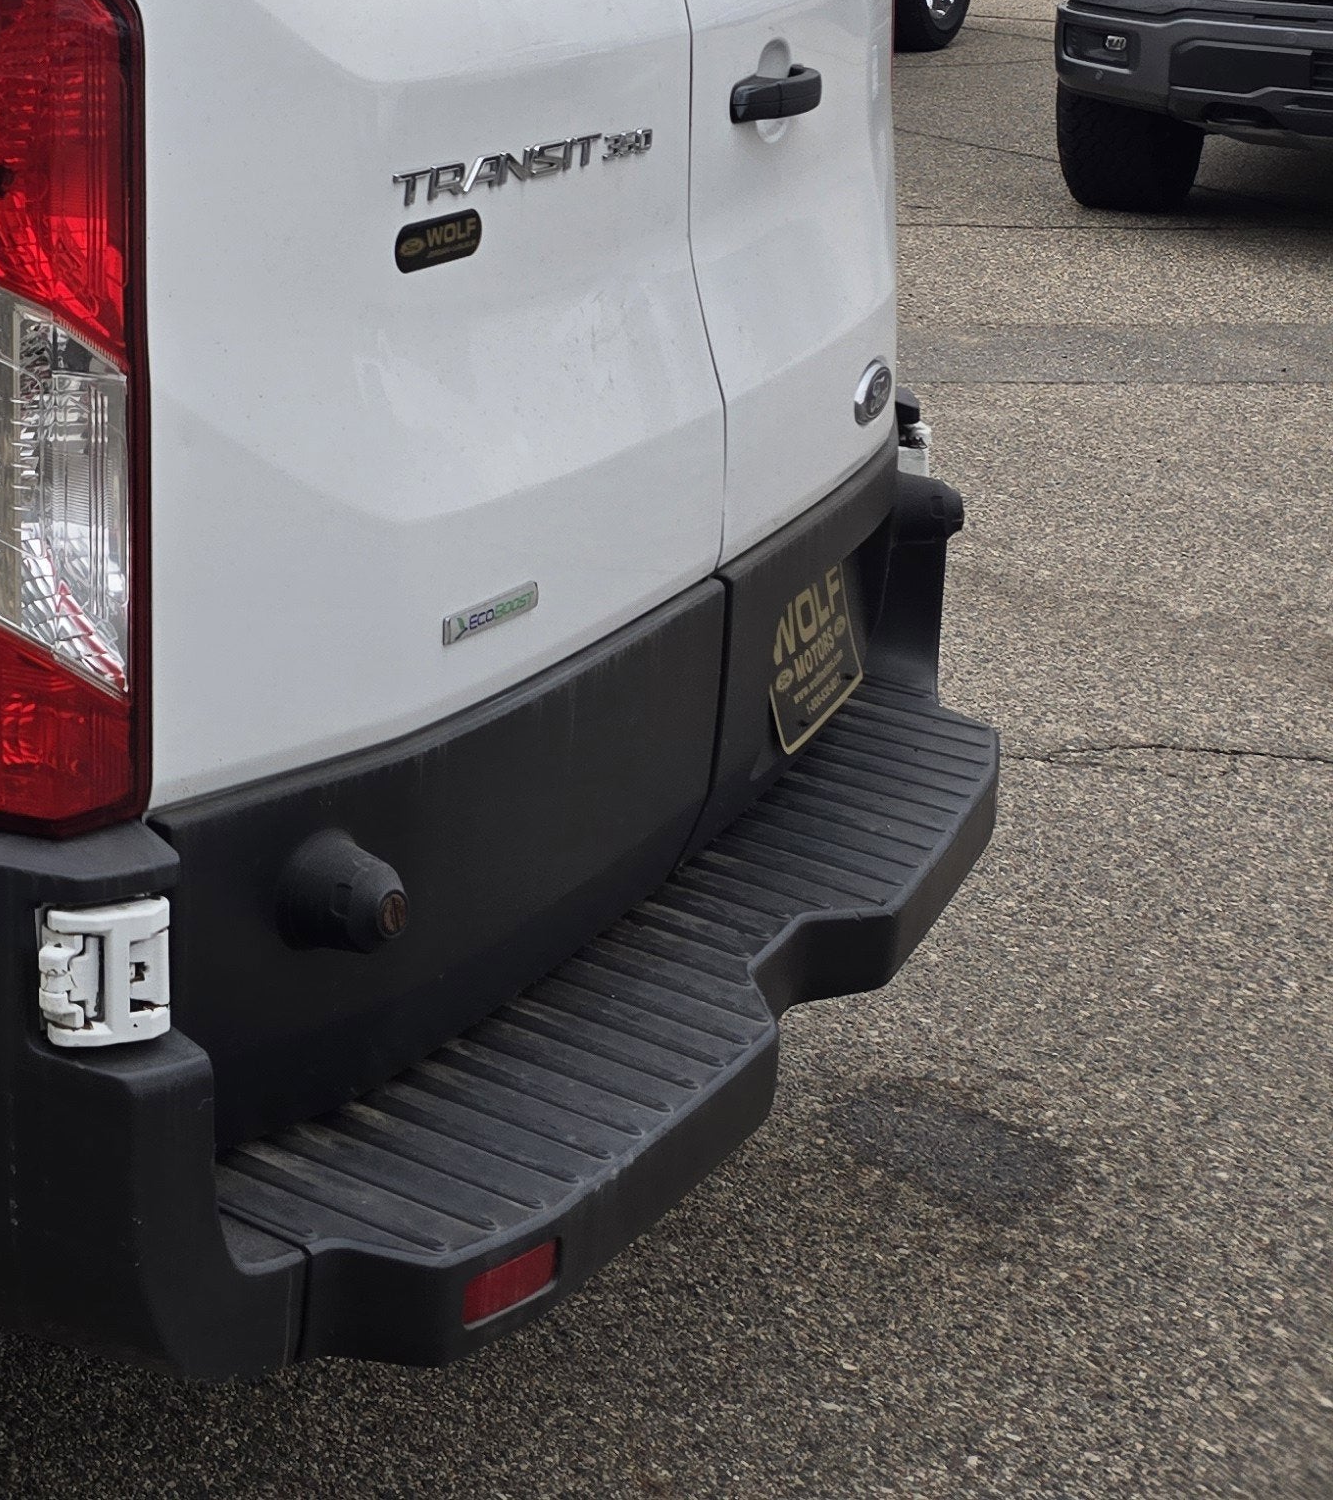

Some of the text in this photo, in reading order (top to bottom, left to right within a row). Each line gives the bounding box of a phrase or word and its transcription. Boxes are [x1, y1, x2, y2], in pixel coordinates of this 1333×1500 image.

[393, 133, 602, 206] TRANSIT
[426, 217, 477, 248] WOLF
[793, 625, 835, 682] MOTORS
